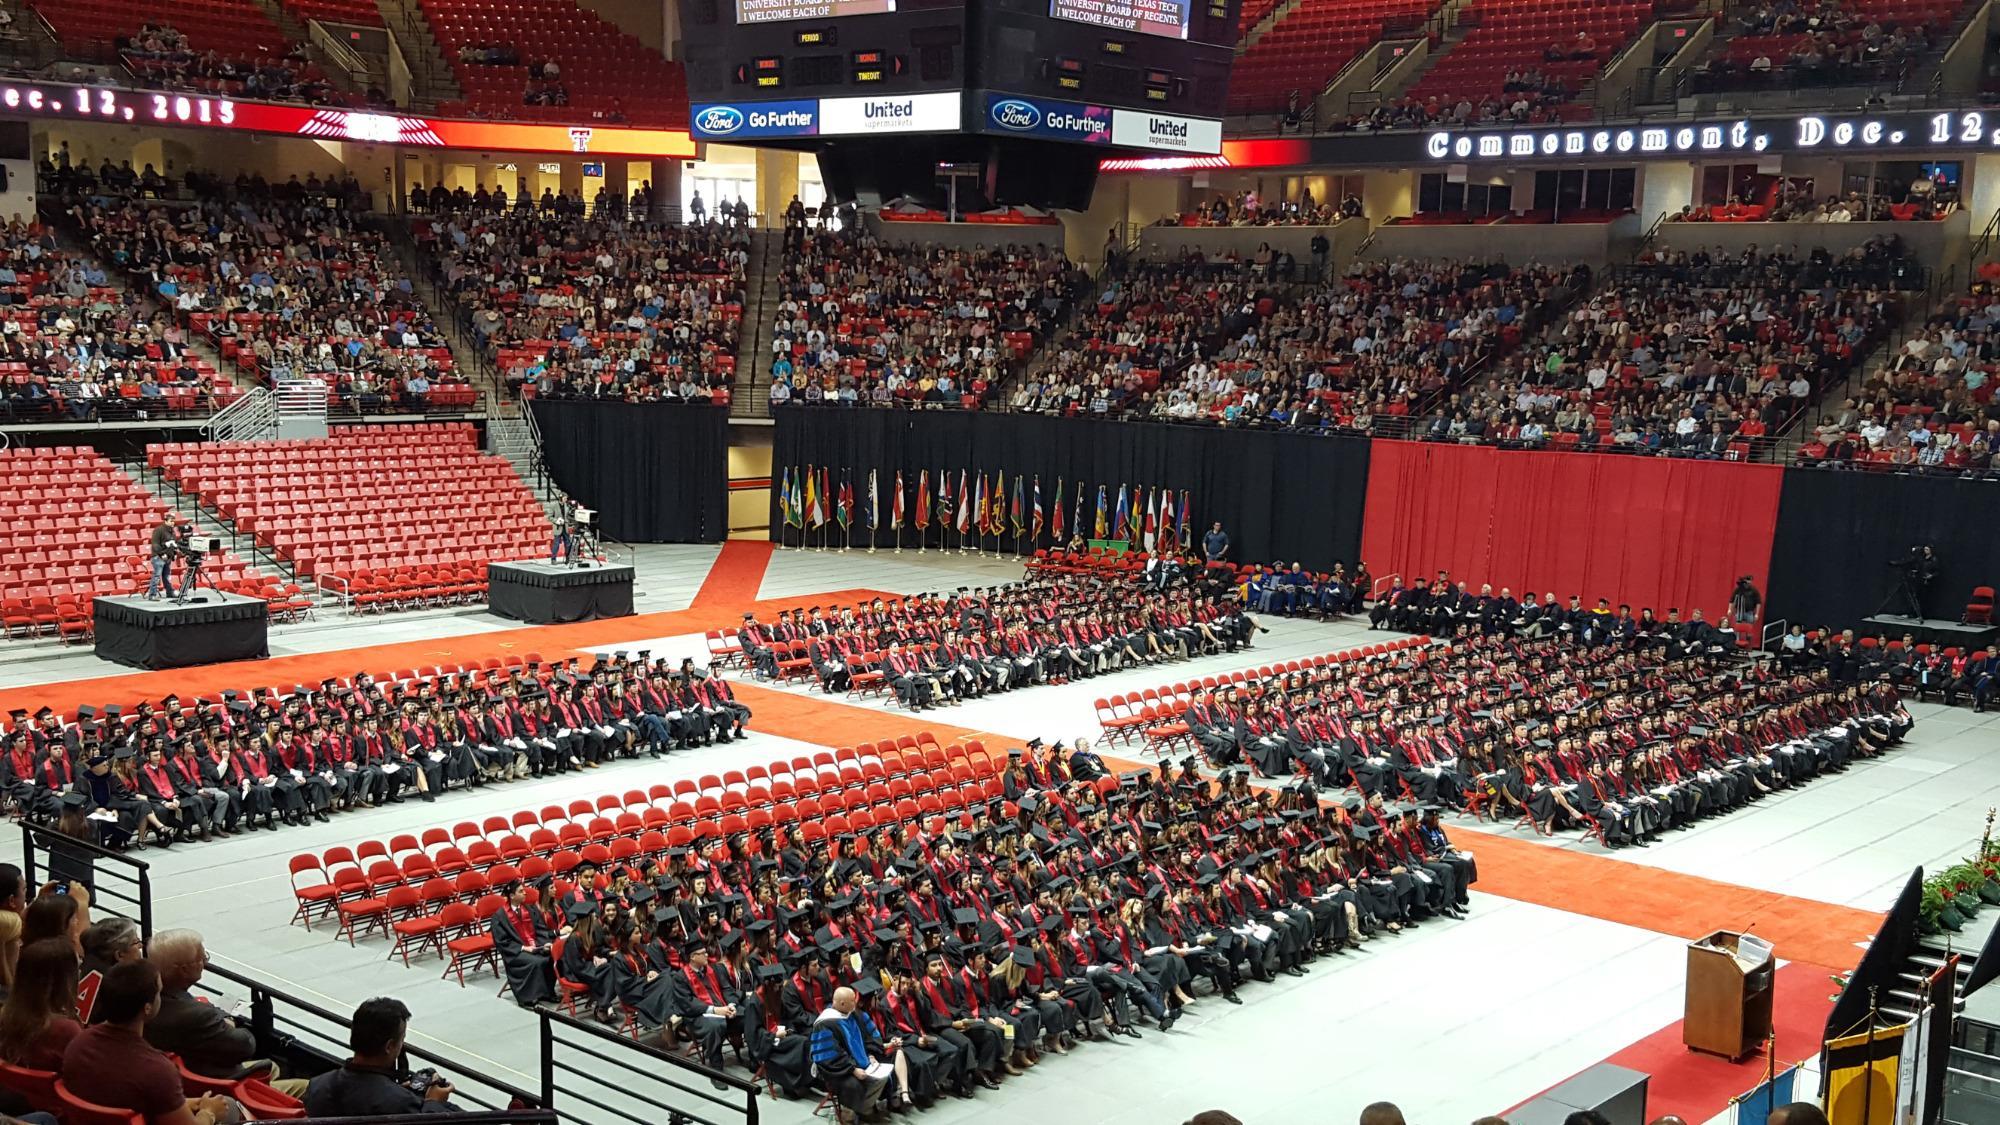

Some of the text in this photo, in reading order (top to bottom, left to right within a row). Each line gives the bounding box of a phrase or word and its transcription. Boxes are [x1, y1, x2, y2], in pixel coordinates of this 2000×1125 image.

[743, 0, 791, 10] UNIVERSITY
[743, 5, 830, 22] I WELCOME EACH OF
[1105, 3, 1131, 17] BOARD
[1132, 8, 1143, 19] OF
[1143, 10, 1180, 26] REGENTS.
[1134, 0, 1157, 10] TEXAS
[1158, 1, 1178, 13] TECH
[1056, 6, 1136, 29] I WELCOME EACH OF
[77, 88, 134, 120] 12,
[153, 95, 234, 124] 2015
[864, 100, 912, 119] United
[1001, 103, 1031, 126] Ford
[704, 111, 734, 130] Ford
[749, 111, 812, 128] Go Further
[864, 118, 913, 130] supermarkets
[1047, 112, 1105, 134] Go Further
[1149, 118, 1187, 137] United
[1149, 135, 1187, 147] supermarkets
[1428, 120, 1768, 158] Commencement,
[1798, 117, 1904, 146] Dec.
